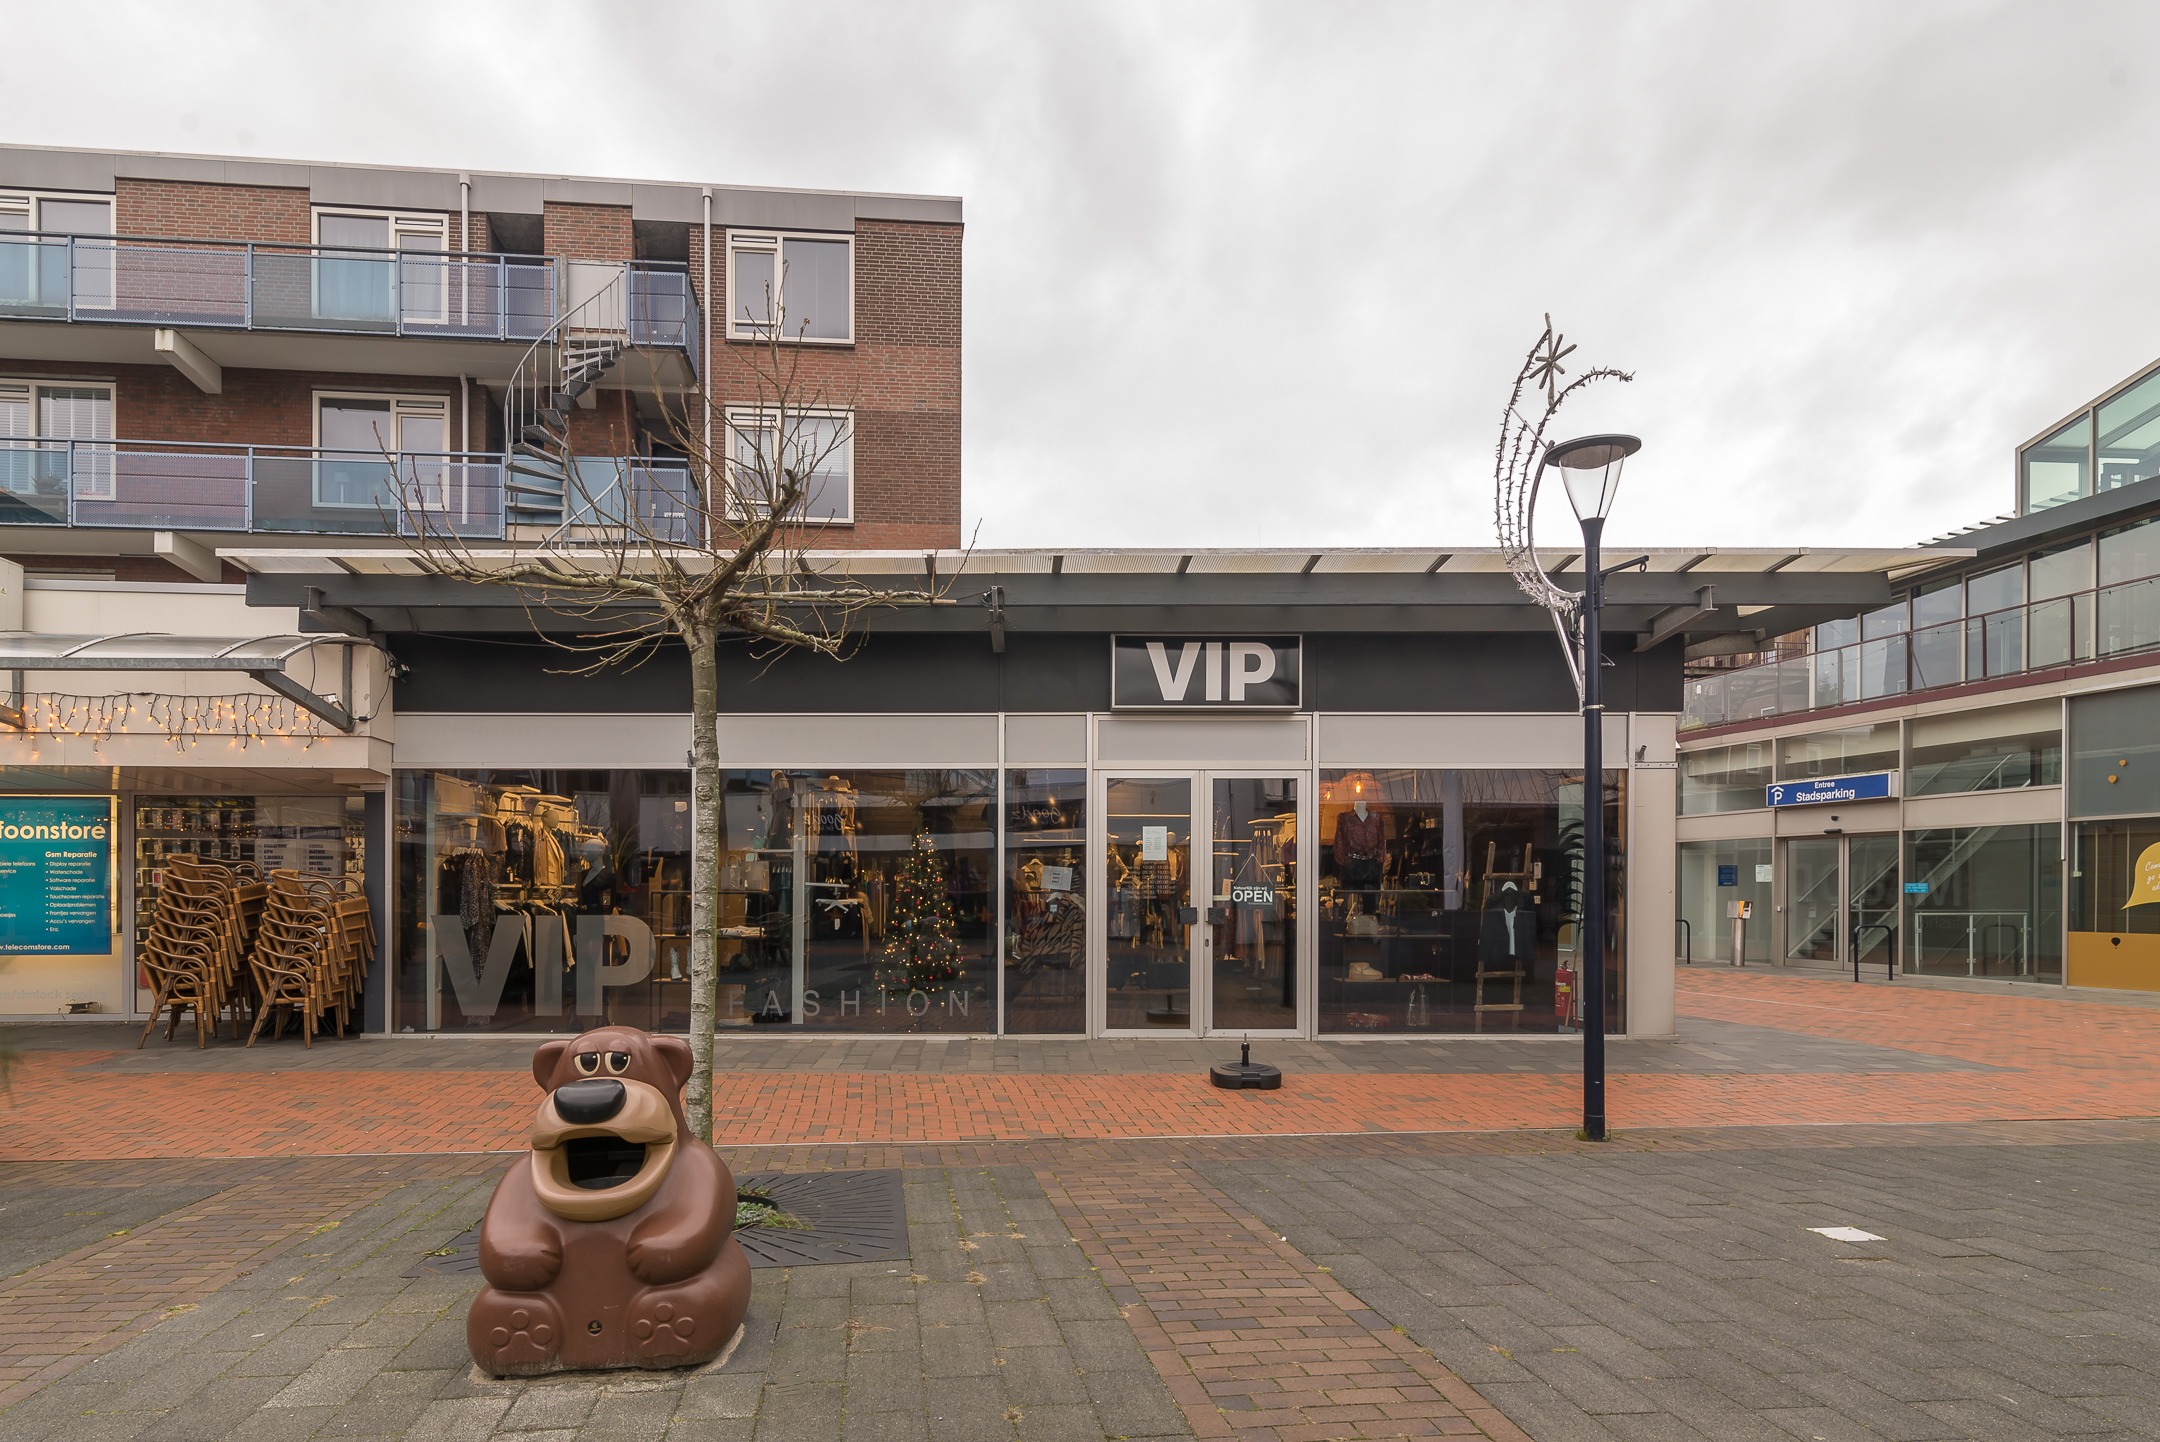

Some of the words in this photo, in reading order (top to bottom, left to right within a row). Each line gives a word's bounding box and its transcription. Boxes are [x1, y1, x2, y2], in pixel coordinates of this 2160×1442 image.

[1146, 642, 1276, 701] VIP
[1814, 781, 1835, 789] Entree
[1796, 788, 1855, 802] Stadsparking
[63, 851, 97, 859] Reparatie
[1232, 890, 1273, 903] OPEN
[431, 914, 656, 1016] VIP
[728, 990, 969, 1017] FASHION
